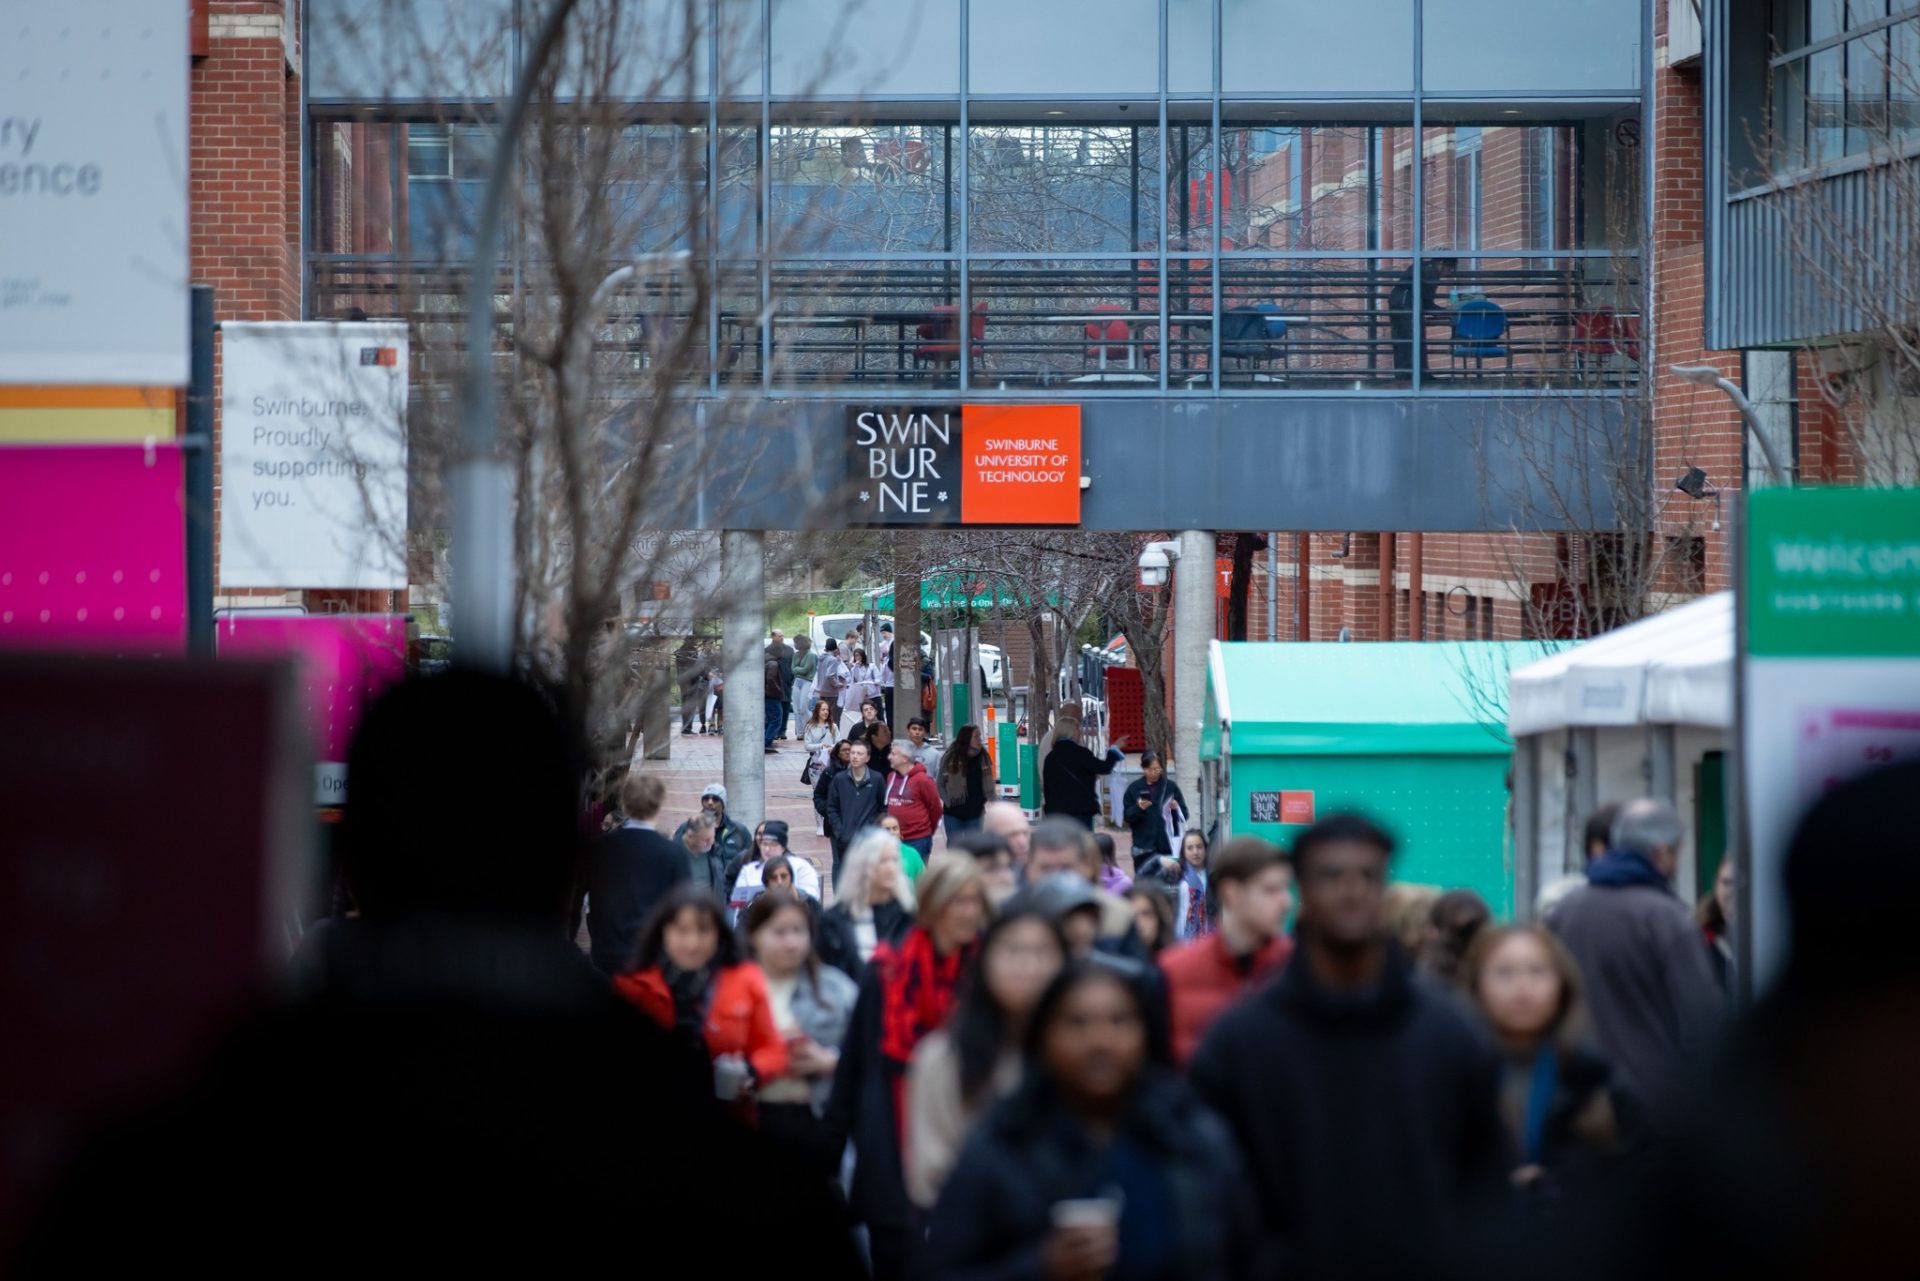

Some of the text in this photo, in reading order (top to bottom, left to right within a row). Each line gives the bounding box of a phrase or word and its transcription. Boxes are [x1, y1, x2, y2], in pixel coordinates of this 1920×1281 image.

[0, 162, 103, 196] ence
[253, 426, 331, 450] Proudly
[985, 438, 1059, 451] SWINBURNE
[869, 447, 941, 480] BUR
[975, 454, 1069, 467] UNIVERSITY OF
[978, 470, 1066, 483] TECHNOLOGY
[252, 490, 295, 511] you.
[878, 481, 931, 513] NE
[1256, 802, 1276, 812] BUR
[1259, 812, 1274, 821] NE
